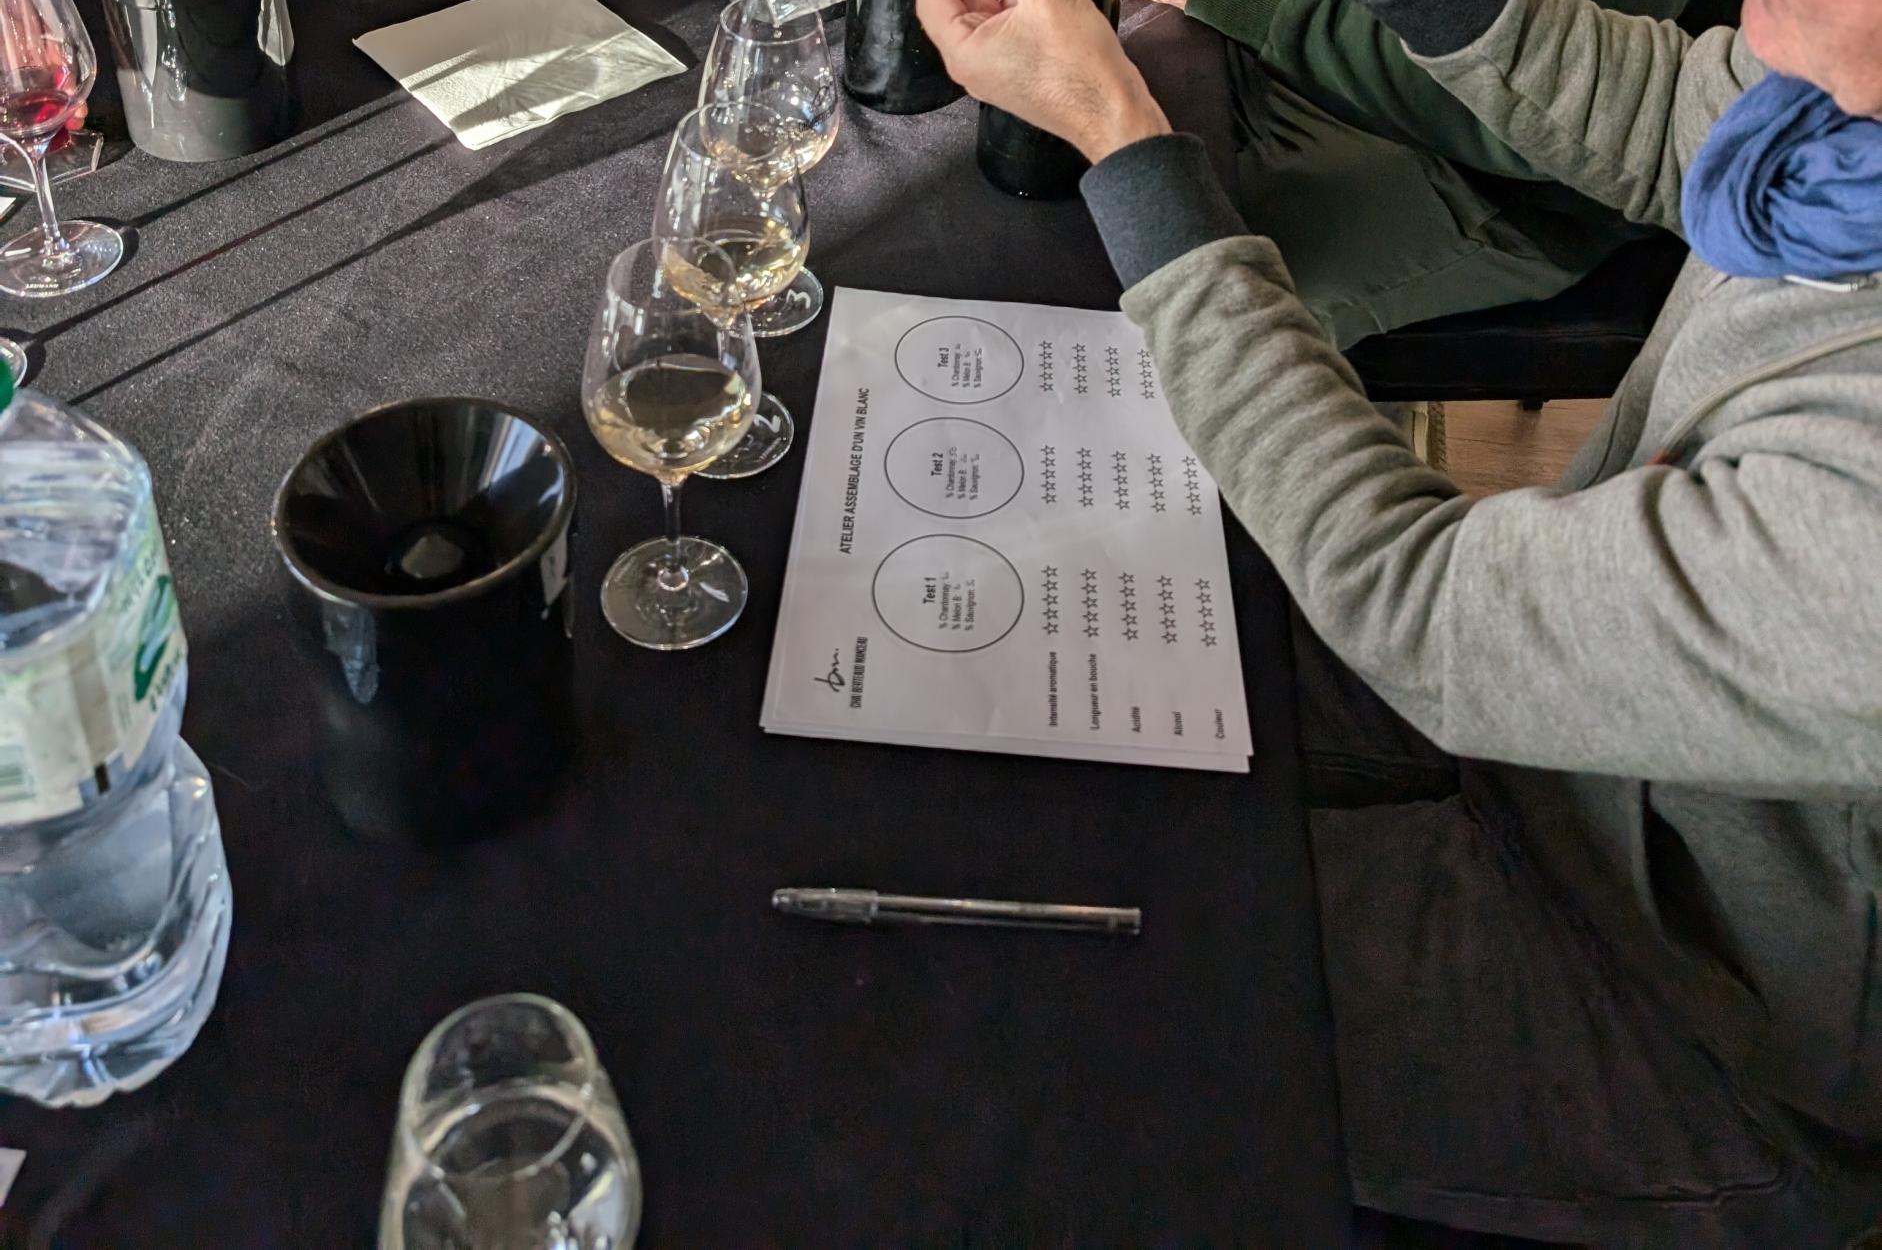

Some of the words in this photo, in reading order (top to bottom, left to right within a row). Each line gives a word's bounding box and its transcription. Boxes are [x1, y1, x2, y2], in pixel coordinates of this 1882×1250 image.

[937, 353, 949, 367] Test
[856, 388, 869, 415] BLANC
[855, 416, 866, 431] VIN
[852, 431, 865, 452] D'UN
[931, 460, 943, 476] Test
[845, 453, 862, 515] ASSEMBLAGE
[840, 515, 855, 554] ATELIER
[923, 584, 936, 604] Test
[1049, 651, 1059, 693] aromatique
[1088, 654, 1098, 681] bouche
[1090, 682, 1098, 692] en
[1048, 694, 1058, 727] Intensité
[1090, 693, 1102, 730] Longueur
[1131, 706, 1141, 733] Acidité
[1172, 711, 1184, 736] Alcool
[1214, 709, 1226, 739] Couleur
